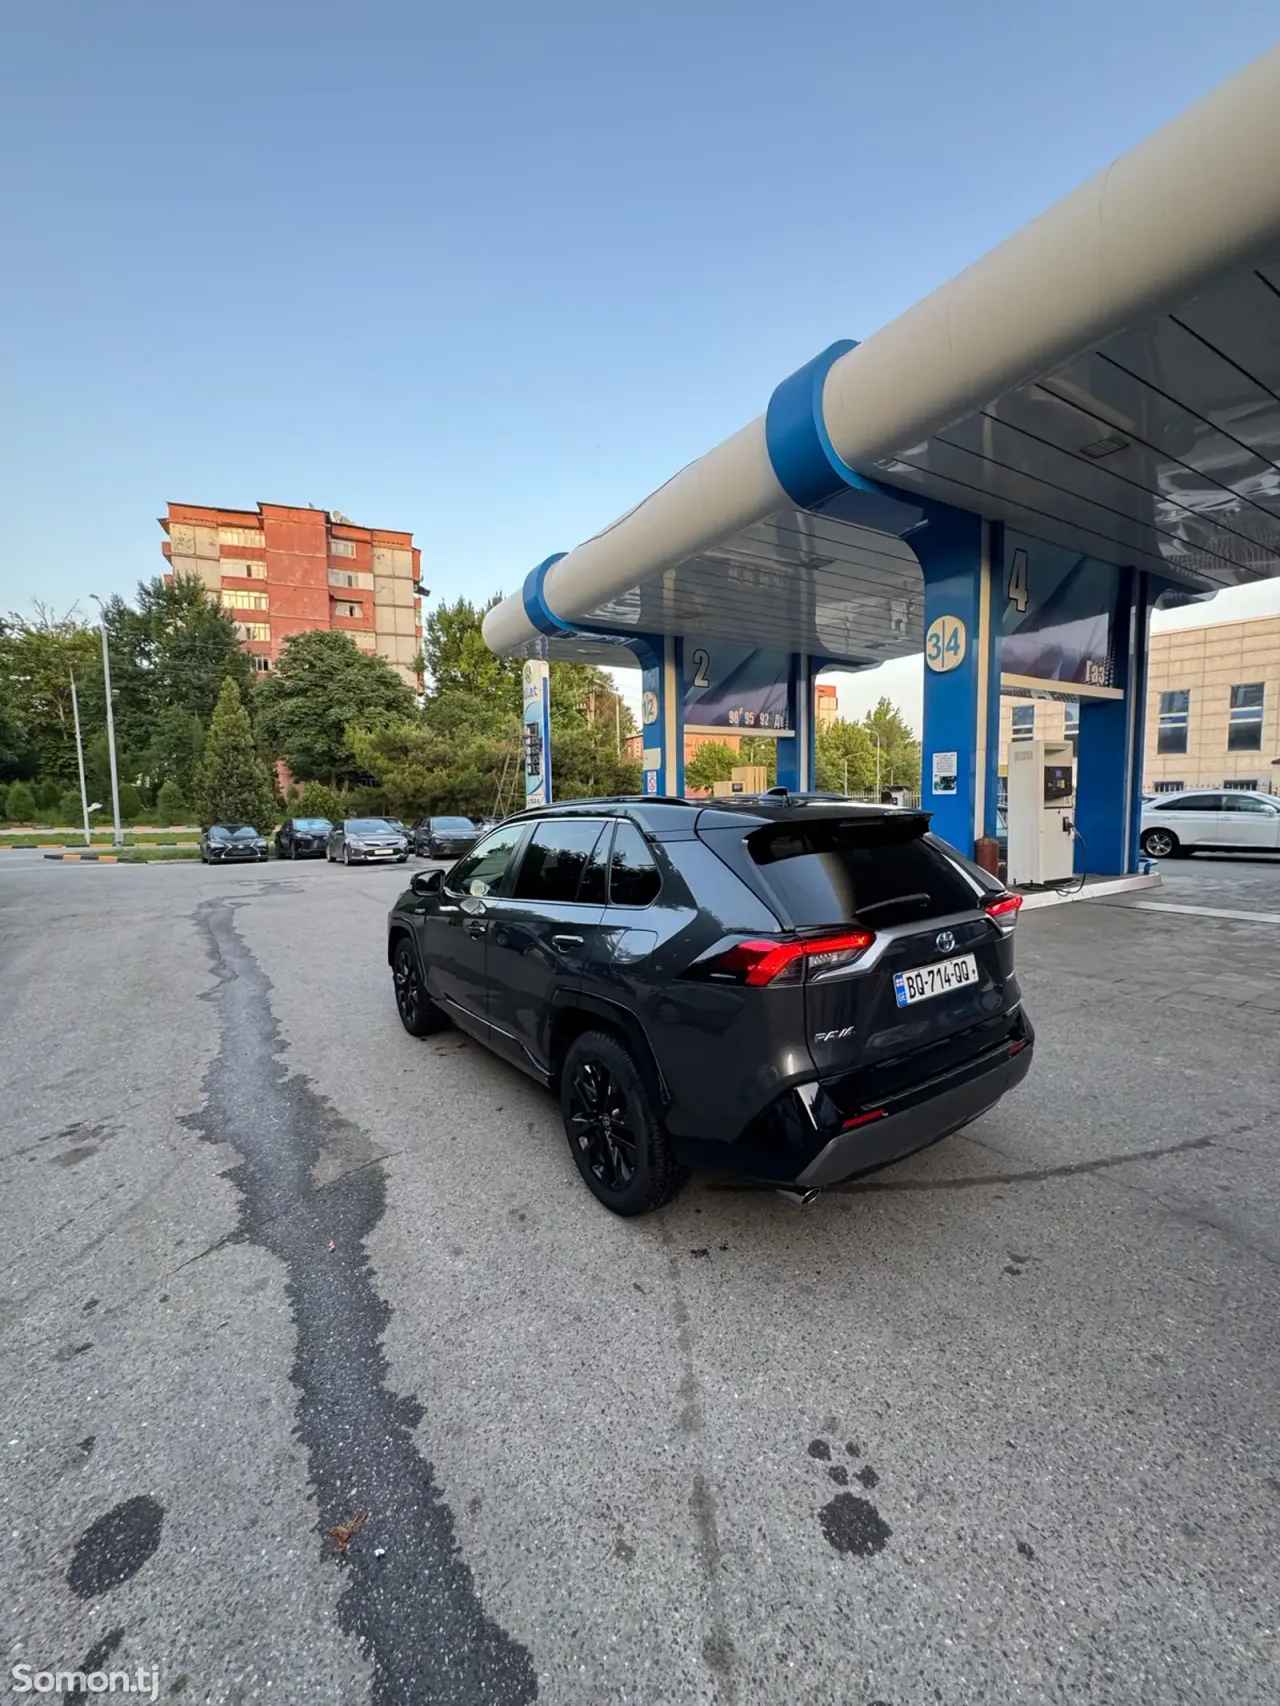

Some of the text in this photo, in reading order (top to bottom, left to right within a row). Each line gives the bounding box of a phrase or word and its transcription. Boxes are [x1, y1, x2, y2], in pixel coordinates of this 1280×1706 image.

[1008, 548, 1028, 613] 4
[927, 627, 960, 661] 3 4
[693, 648, 710, 688] 2
[728, 710, 739, 724] 98
[744, 711, 755, 725] 95
[760, 712, 769, 726] 92
[906, 960, 970, 999] BQ-714-QQ
